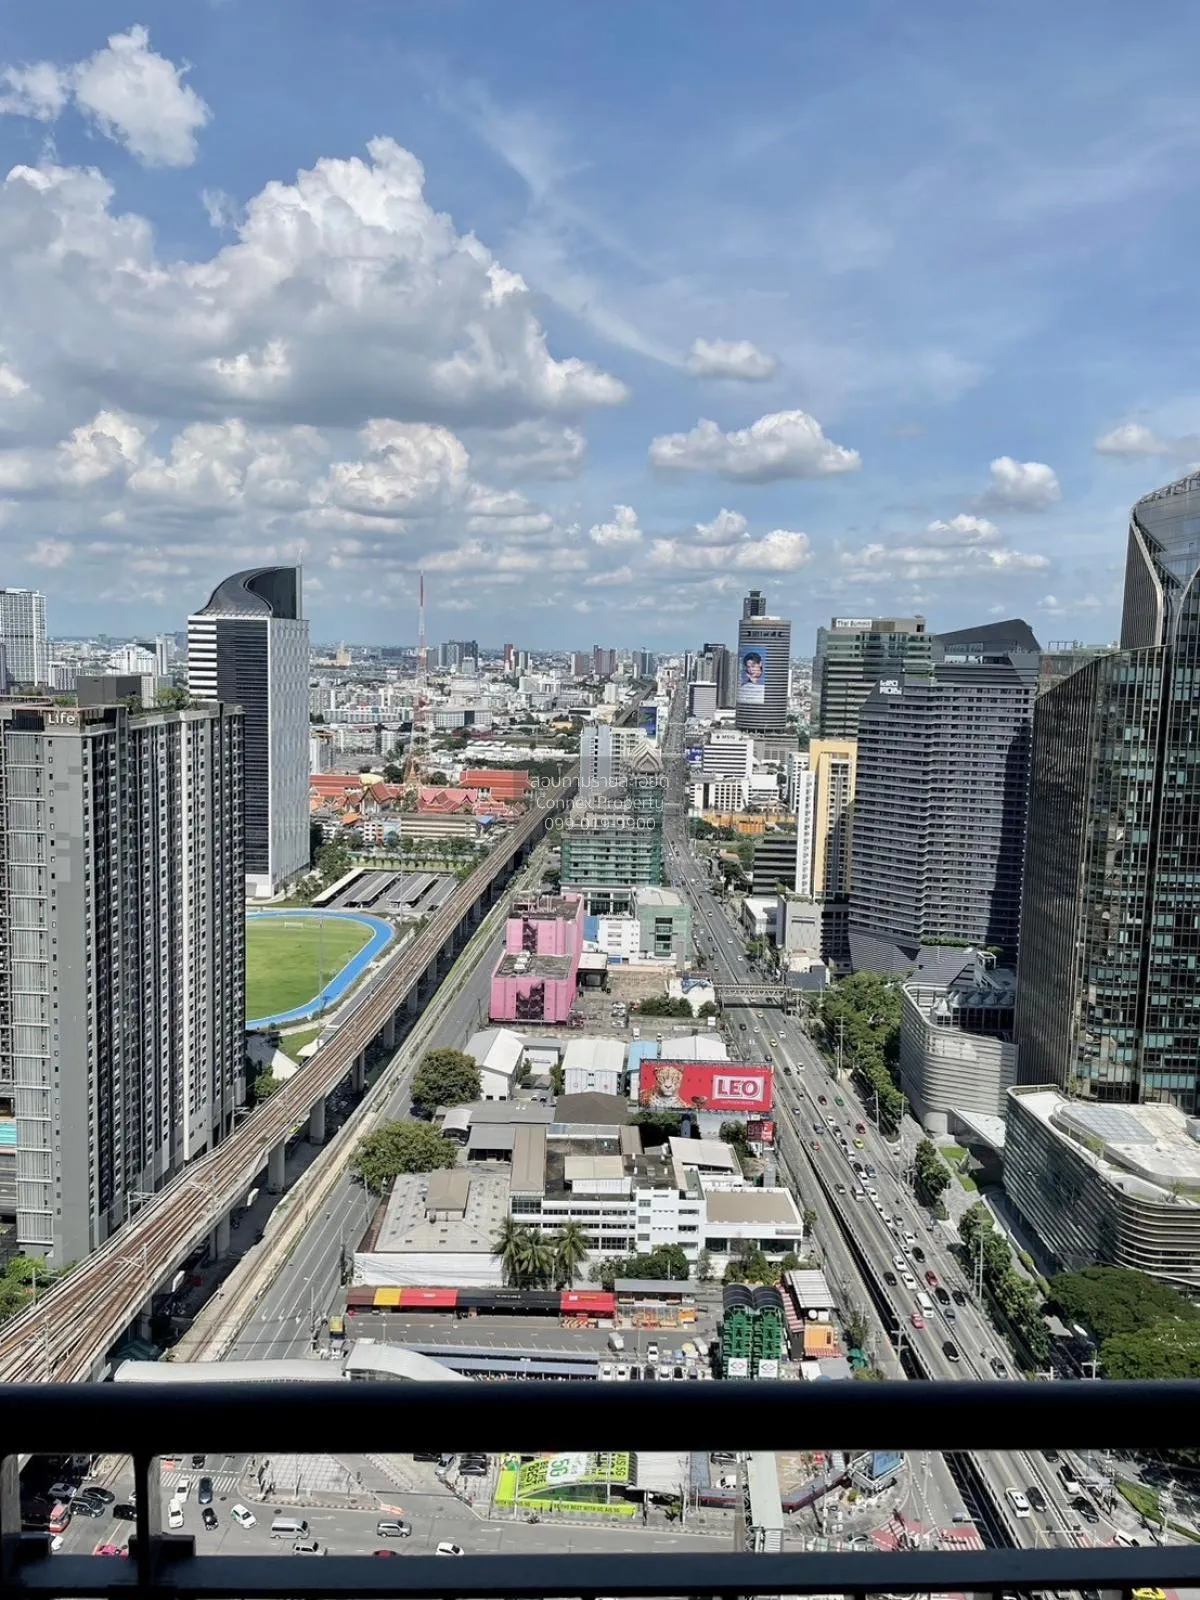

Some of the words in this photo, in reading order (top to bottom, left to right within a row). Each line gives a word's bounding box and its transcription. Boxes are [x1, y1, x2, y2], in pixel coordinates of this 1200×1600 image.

[48, 711, 75, 724] Life
[717, 1079, 759, 1097] LEO
[550, 1458, 570, 1477] 5G
